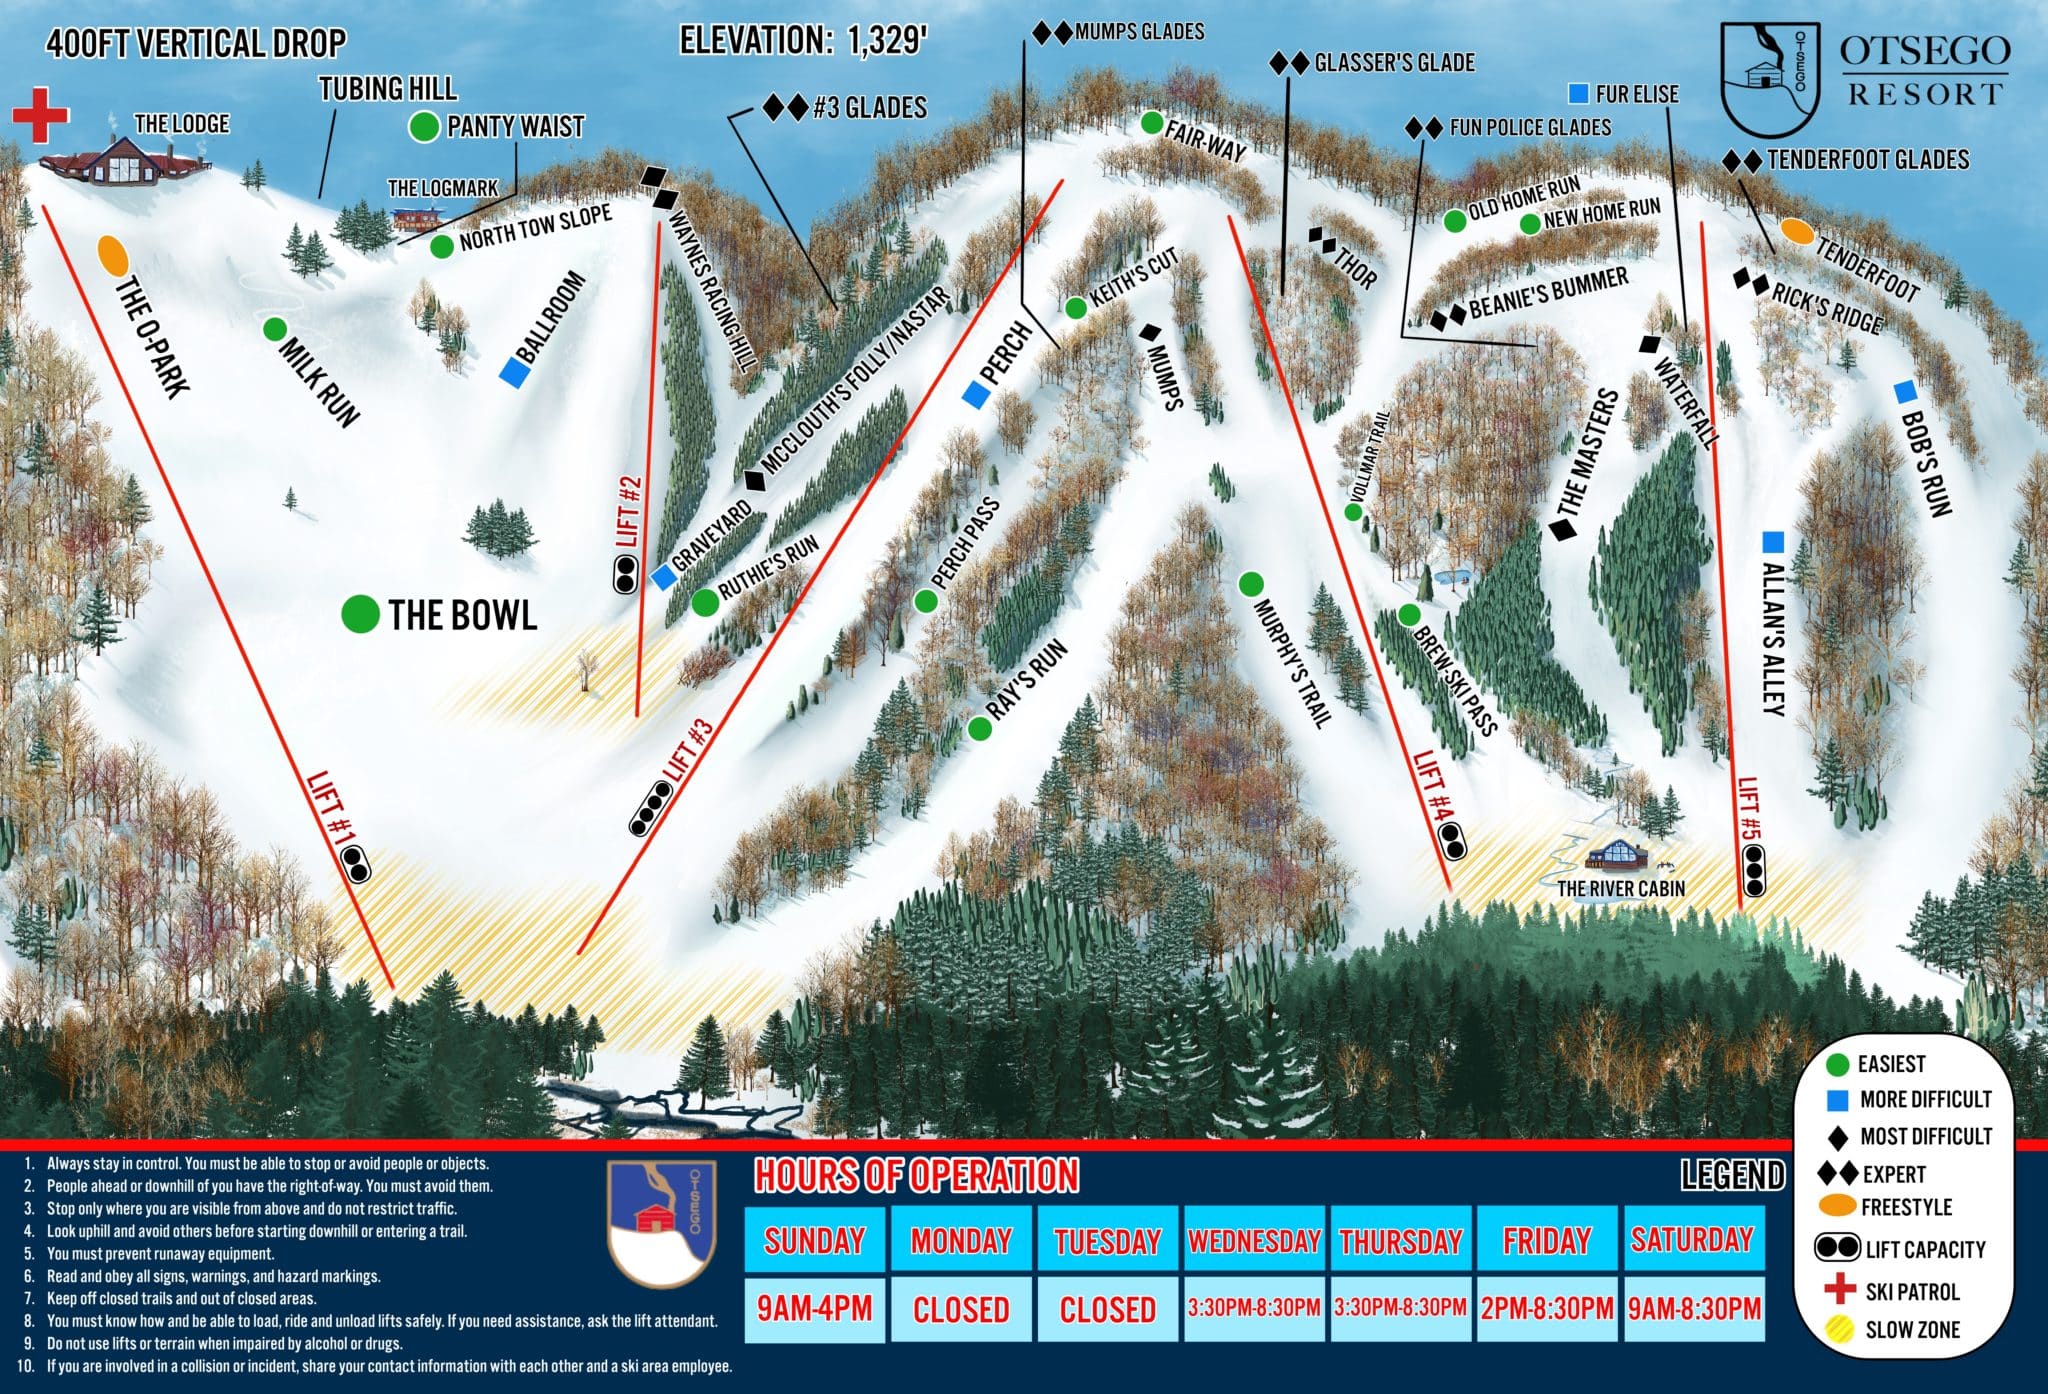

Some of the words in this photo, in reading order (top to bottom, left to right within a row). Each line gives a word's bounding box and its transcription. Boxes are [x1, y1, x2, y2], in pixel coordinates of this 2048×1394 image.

[46, 27, 130, 58] 400FT
[136, 27, 266, 58] VERTICAL
[273, 28, 346, 58] DROP
[680, 24, 833, 54] ELEVATION:
[848, 24, 927, 60] 1,329'
[1075, 21, 1138, 40] MUMPS
[1141, 21, 1205, 40] GLADES
[1315, 52, 1413, 72] GLASSER'S
[1417, 52, 1475, 72] GLADE
[1795, 31, 1806, 92] OTSEGO
[1839, 35, 2011, 65] OTSEGO
[318, 75, 403, 101] TUBING
[409, 75, 458, 101] HILL
[1596, 84, 1629, 104] FUR
[1633, 84, 1679, 104] ELISE
[1849, 82, 2003, 106] RESORT
[813, 95, 840, 119] #3
[845, 95, 927, 119] GLADES
[134, 113, 168, 133] THE
[172, 113, 229, 133] LODGE
[448, 114, 515, 137] PANTY
[520, 114, 585, 138] WAIST
[1450, 118, 1482, 136] FUN
[1486, 117, 1544, 136] POLICE
[1548, 117, 1612, 136] GLADES
[1164, 118, 1247, 164] FAIR-WAY
[1766, 148, 1891, 170] TENDERFOOT
[1895, 148, 1970, 170] GLADES
[387, 179, 418, 197] THE
[421, 179, 498, 197] LOGMARK
[1468, 197, 1499, 221] OLD
[1500, 183, 1547, 212] HOME
[1546, 173, 1581, 199] RUN
[459, 222, 516, 252] NORTH
[517, 214, 555, 239] TOW
[558, 202, 613, 230] SLOPE
[1543, 207, 1578, 229] NEW
[1581, 201, 1627, 224] HOME
[1628, 196, 1661, 217] RUN
[1088, 264, 1149, 308] KEITH'S
[1147, 245, 1179, 275] CUT
[1333, 245, 1378, 291] THOR
[1816, 235, 1921, 303] TENDERFOOT
[668, 209, 712, 278] WAYNES
[699, 275, 741, 338] RACING
[728, 335, 757, 374] HILL
[1468, 283, 1549, 320] BEANIE'S
[1550, 265, 1630, 301] BUMMER
[514, 269, 586, 365] BALLROOM
[1771, 281, 1831, 317] RICK'S
[1830, 301, 1885, 336] RIDGE
[115, 273, 153, 322] THE
[135, 319, 191, 401] O-PARK
[979, 319, 1033, 386] PERCH
[277, 335, 329, 391] MILK
[316, 381, 361, 429] RUN
[759, 383, 852, 475] MCCLOUTH'S
[844, 285, 951, 391] FOLLY/NASTAR
[1146, 344, 1184, 412] MUMPS
[1653, 355, 1720, 452] WATERFALL
[1570, 387, 1619, 480] MASTERS
[1349, 445, 1379, 503] VOLLMAR
[1367, 411, 1391, 444] TRAIL
[1901, 410, 1939, 473] BOB'S
[1920, 473, 1953, 519] RUN
[618, 475, 642, 502] #2
[1556, 478, 1588, 516] THE
[614, 505, 639, 548] LIFT
[671, 498, 752, 572] GRAVEYARD
[930, 535, 974, 590] PERCH
[962, 495, 1000, 540] PASS
[717, 552, 787, 601] RUTHIE'S
[784, 533, 820, 564] RUN
[387, 598, 443, 631] THE
[451, 598, 538, 631] BOWL
[1762, 562, 1786, 649] ALLAN'S
[1252, 597, 1309, 683] MURPHY'S
[1297, 679, 1332, 730] TRAIL
[984, 669, 1036, 722] RAY'S
[1028, 637, 1069, 678] RUN
[1412, 624, 1472, 699] BREW-SKI
[1461, 693, 1499, 738] PASS
[1762, 653, 1785, 717] ALLEY
[661, 740, 697, 783] LIFT
[689, 718, 714, 745] #3
[1412, 749, 1446, 791] LIFT
[305, 769, 345, 815] LIFT
[327, 818, 357, 846] #1
[1428, 795, 1455, 822] #4
[1737, 776, 1760, 813] LIFT
[1741, 817, 1762, 841] #5
[1556, 879, 1586, 897] THE
[1589, 879, 1634, 897] RIVER
[1638, 879, 1685, 897] CABIN
[1858, 1054, 1927, 1073] EASIEST
[1860, 1089, 1908, 1109] MORE
[1911, 1089, 1993, 1108] DIFFICULT
[1861, 1126, 1908, 1146] MOST
[1912, 1126, 1993, 1146] DIFFICULT
[23, 1178, 35, 1193] 2.
[46, 1178, 88, 1196] People
[90, 1178, 128, 1193] ahead
[129, 1181, 143, 1193] or
[144, 1178, 194, 1193] downhill
[196, 1178, 210, 1193] of
[211, 1181, 233, 1196] you
[235, 1178, 264, 1193] have
[266, 1178, 287, 1193] the
[289, 1178, 363, 1196] right-of-way.
[365, 1178, 388, 1193] You
[390, 1179, 422, 1193] must
[423, 1178, 456, 1193] avoid
[458, 1178, 493, 1193] them.
[756, 1158, 858, 1192] HOURS
[865, 1158, 903, 1192] OF
[910, 1158, 1078, 1192] OPERATION
[1682, 1159, 1785, 1190] LEGEND
[1863, 1165, 1927, 1184] EXPERT
[689, 1168, 701, 1235] OTSEGO
[1861, 1197, 1953, 1217] FREESTYLE
[764, 1226, 865, 1254] SUNDAY
[911, 1227, 1012, 1254] MONDAY
[1054, 1228, 1161, 1255] TUESDAY
[1188, 1229, 1321, 1253] WEDNESDAY
[1339, 1228, 1462, 1255] THURSDAY
[1503, 1226, 1591, 1255] FRIDAY
[1631, 1226, 1753, 1252] SATURDAY
[1866, 1240, 1901, 1259] LIFT
[1904, 1240, 1986, 1259] CAPACITY
[23, 1268, 35, 1283] 6.
[46, 1268, 78, 1283] Read
[79, 1268, 102, 1283] and
[104, 1268, 134, 1286] obey
[135, 1268, 151, 1283] all
[152, 1268, 189, 1286] signs,
[190, 1271, 250, 1286] warnings,
[252, 1268, 275, 1283] and
[277, 1268, 319, 1283] hazard
[321, 1268, 381, 1286] markings.
[1865, 1282, 1893, 1301] SKI
[1897, 1282, 1961, 1301] PATROL
[757, 1294, 872, 1322] 9AM-4PM
[913, 1295, 1010, 1324] CLOSED
[1060, 1295, 1156, 1324] CLOSED
[1188, 1297, 1321, 1317] 3:30PM-8:30PM
[1335, 1297, 1467, 1316] 3:30PM-8:30PM
[1481, 1295, 1614, 1320] 2PM-8:30PM
[1628, 1295, 1761, 1321] 9AM-8:30PM
[1865, 1320, 1914, 1339] SLOW
[1917, 1320, 1961, 1339] ZONE
